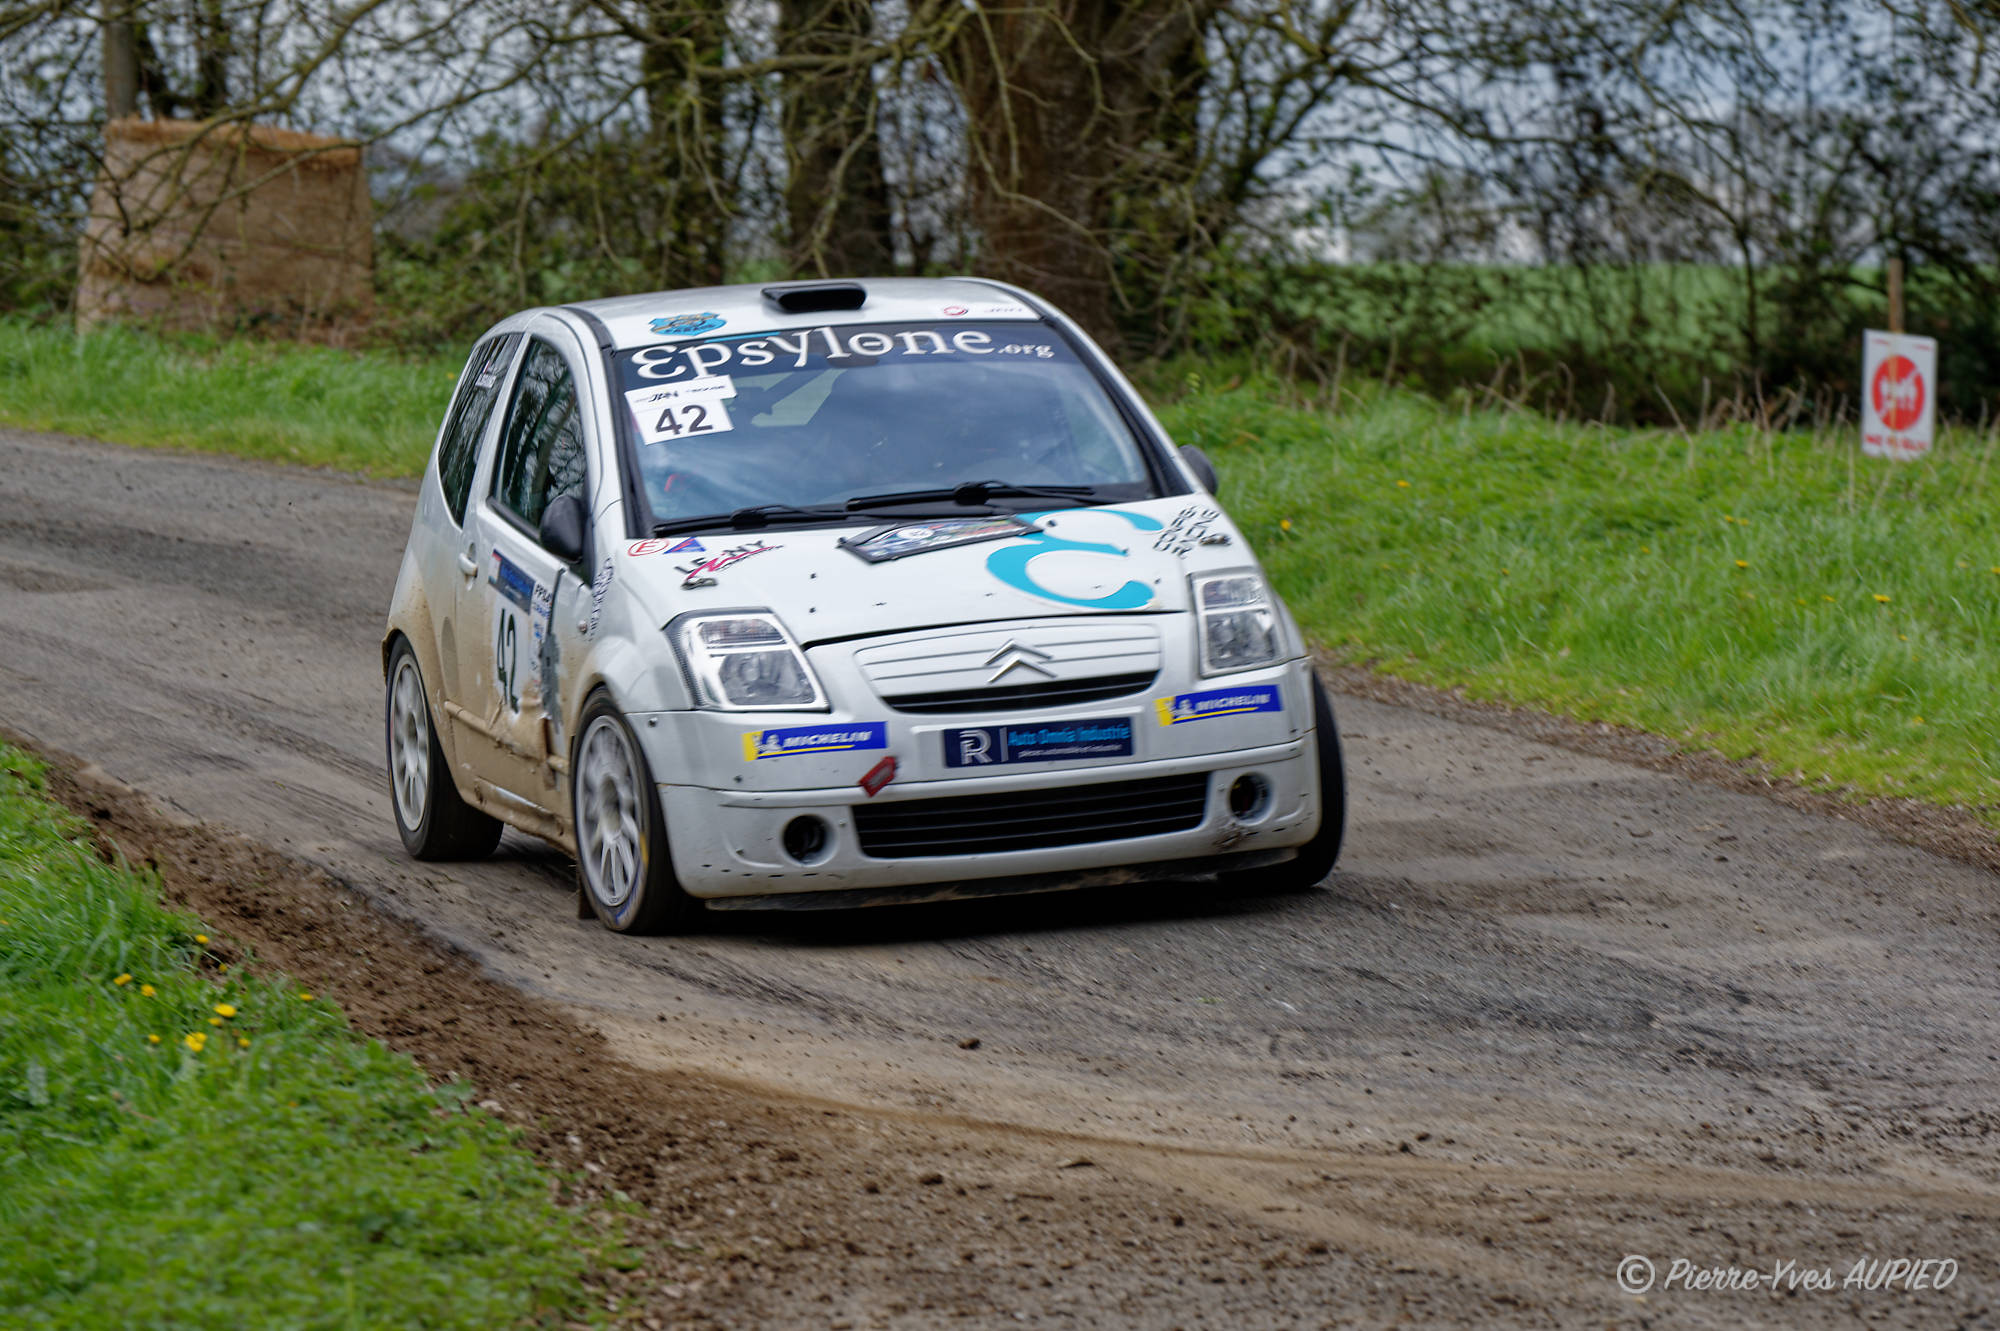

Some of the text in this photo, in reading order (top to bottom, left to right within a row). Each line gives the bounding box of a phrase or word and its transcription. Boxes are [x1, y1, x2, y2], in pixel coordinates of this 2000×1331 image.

[655, 404, 714, 435] 42
[497, 608, 519, 714] 42
[1195, 693, 1272, 712] MICHELIN
[782, 730, 873, 748] MICHELIN
